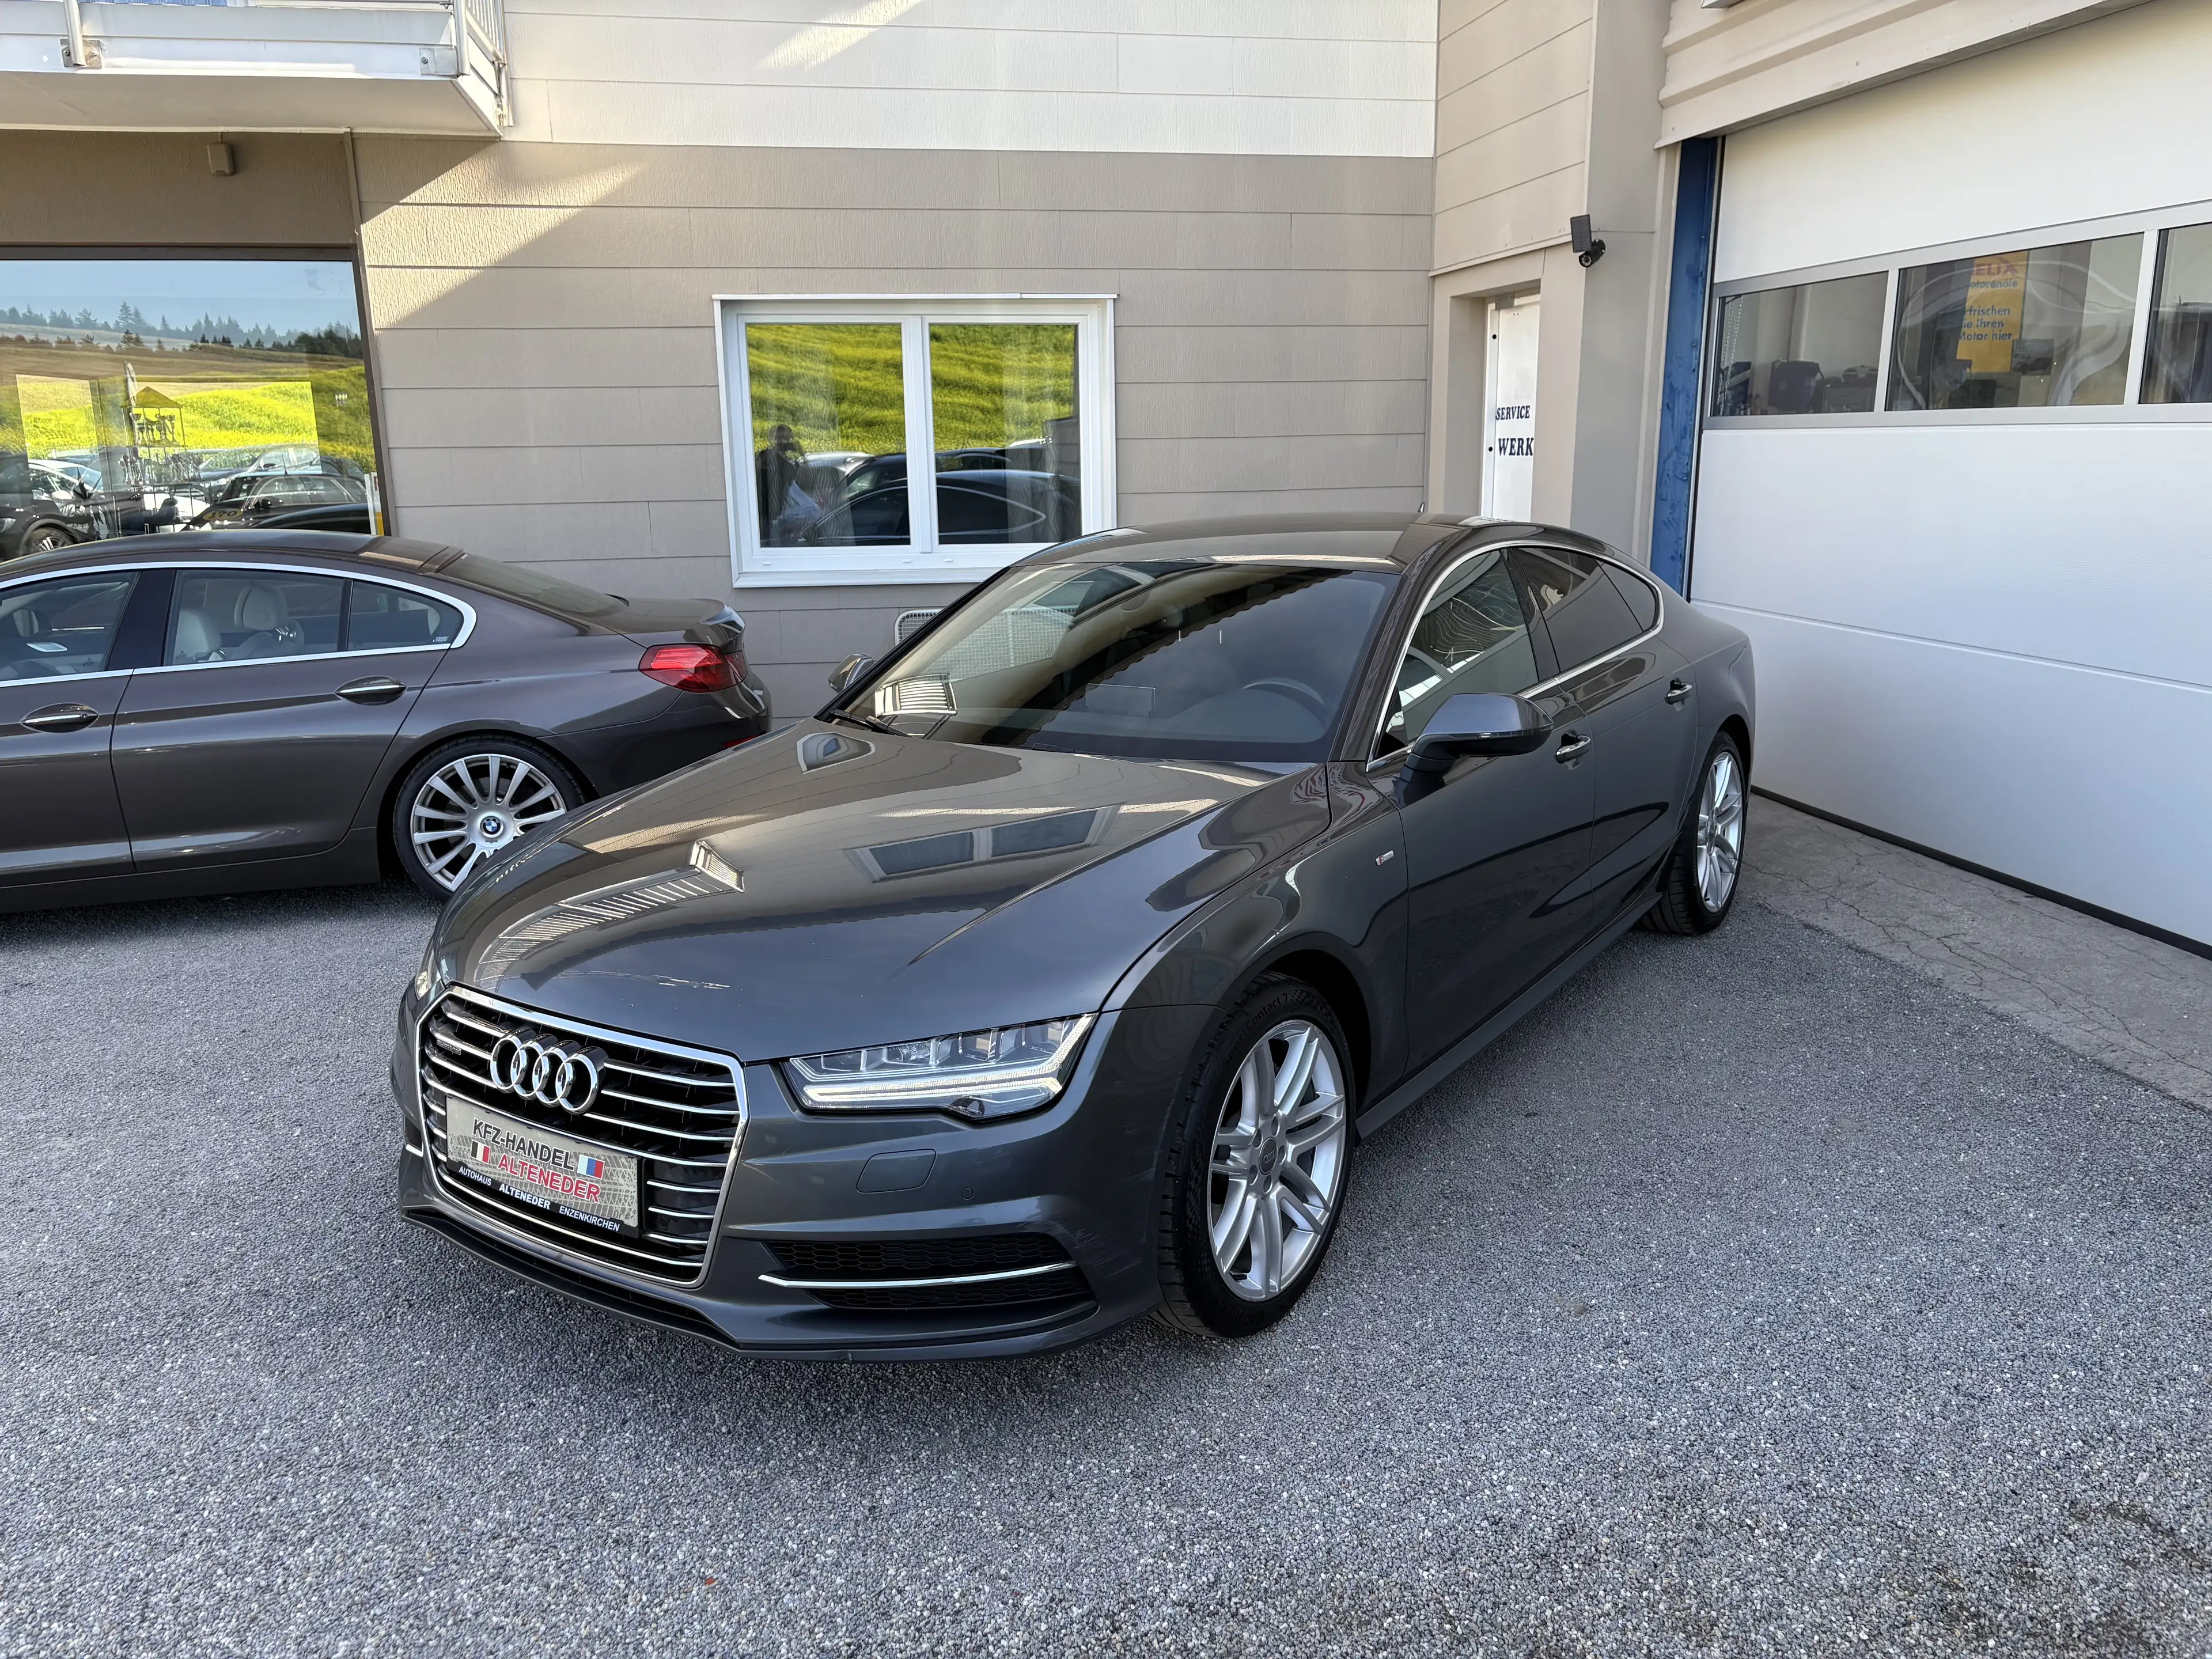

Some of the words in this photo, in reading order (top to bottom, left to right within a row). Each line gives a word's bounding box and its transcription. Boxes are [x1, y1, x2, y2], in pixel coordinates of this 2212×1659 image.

[1974, 257, 2018, 276] ELIX
[1970, 278, 2018, 288] otorenöle
[1963, 318, 1973, 328] ie
[1976, 317, 2004, 328] Ihren
[1992, 329, 2013, 340] hier
[1495, 406, 1531, 421] SERVICE
[1498, 437, 1534, 456] WERK
[472, 1118, 574, 1171] KFZ-HANDEL
[498, 1154, 601, 1204] ALTENEDER
[459, 1166, 492, 1187] AUTOHAUS
[499, 1183, 551, 1210] ALTENEDER
[559, 1206, 620, 1232] ENZENKIRCHEN
